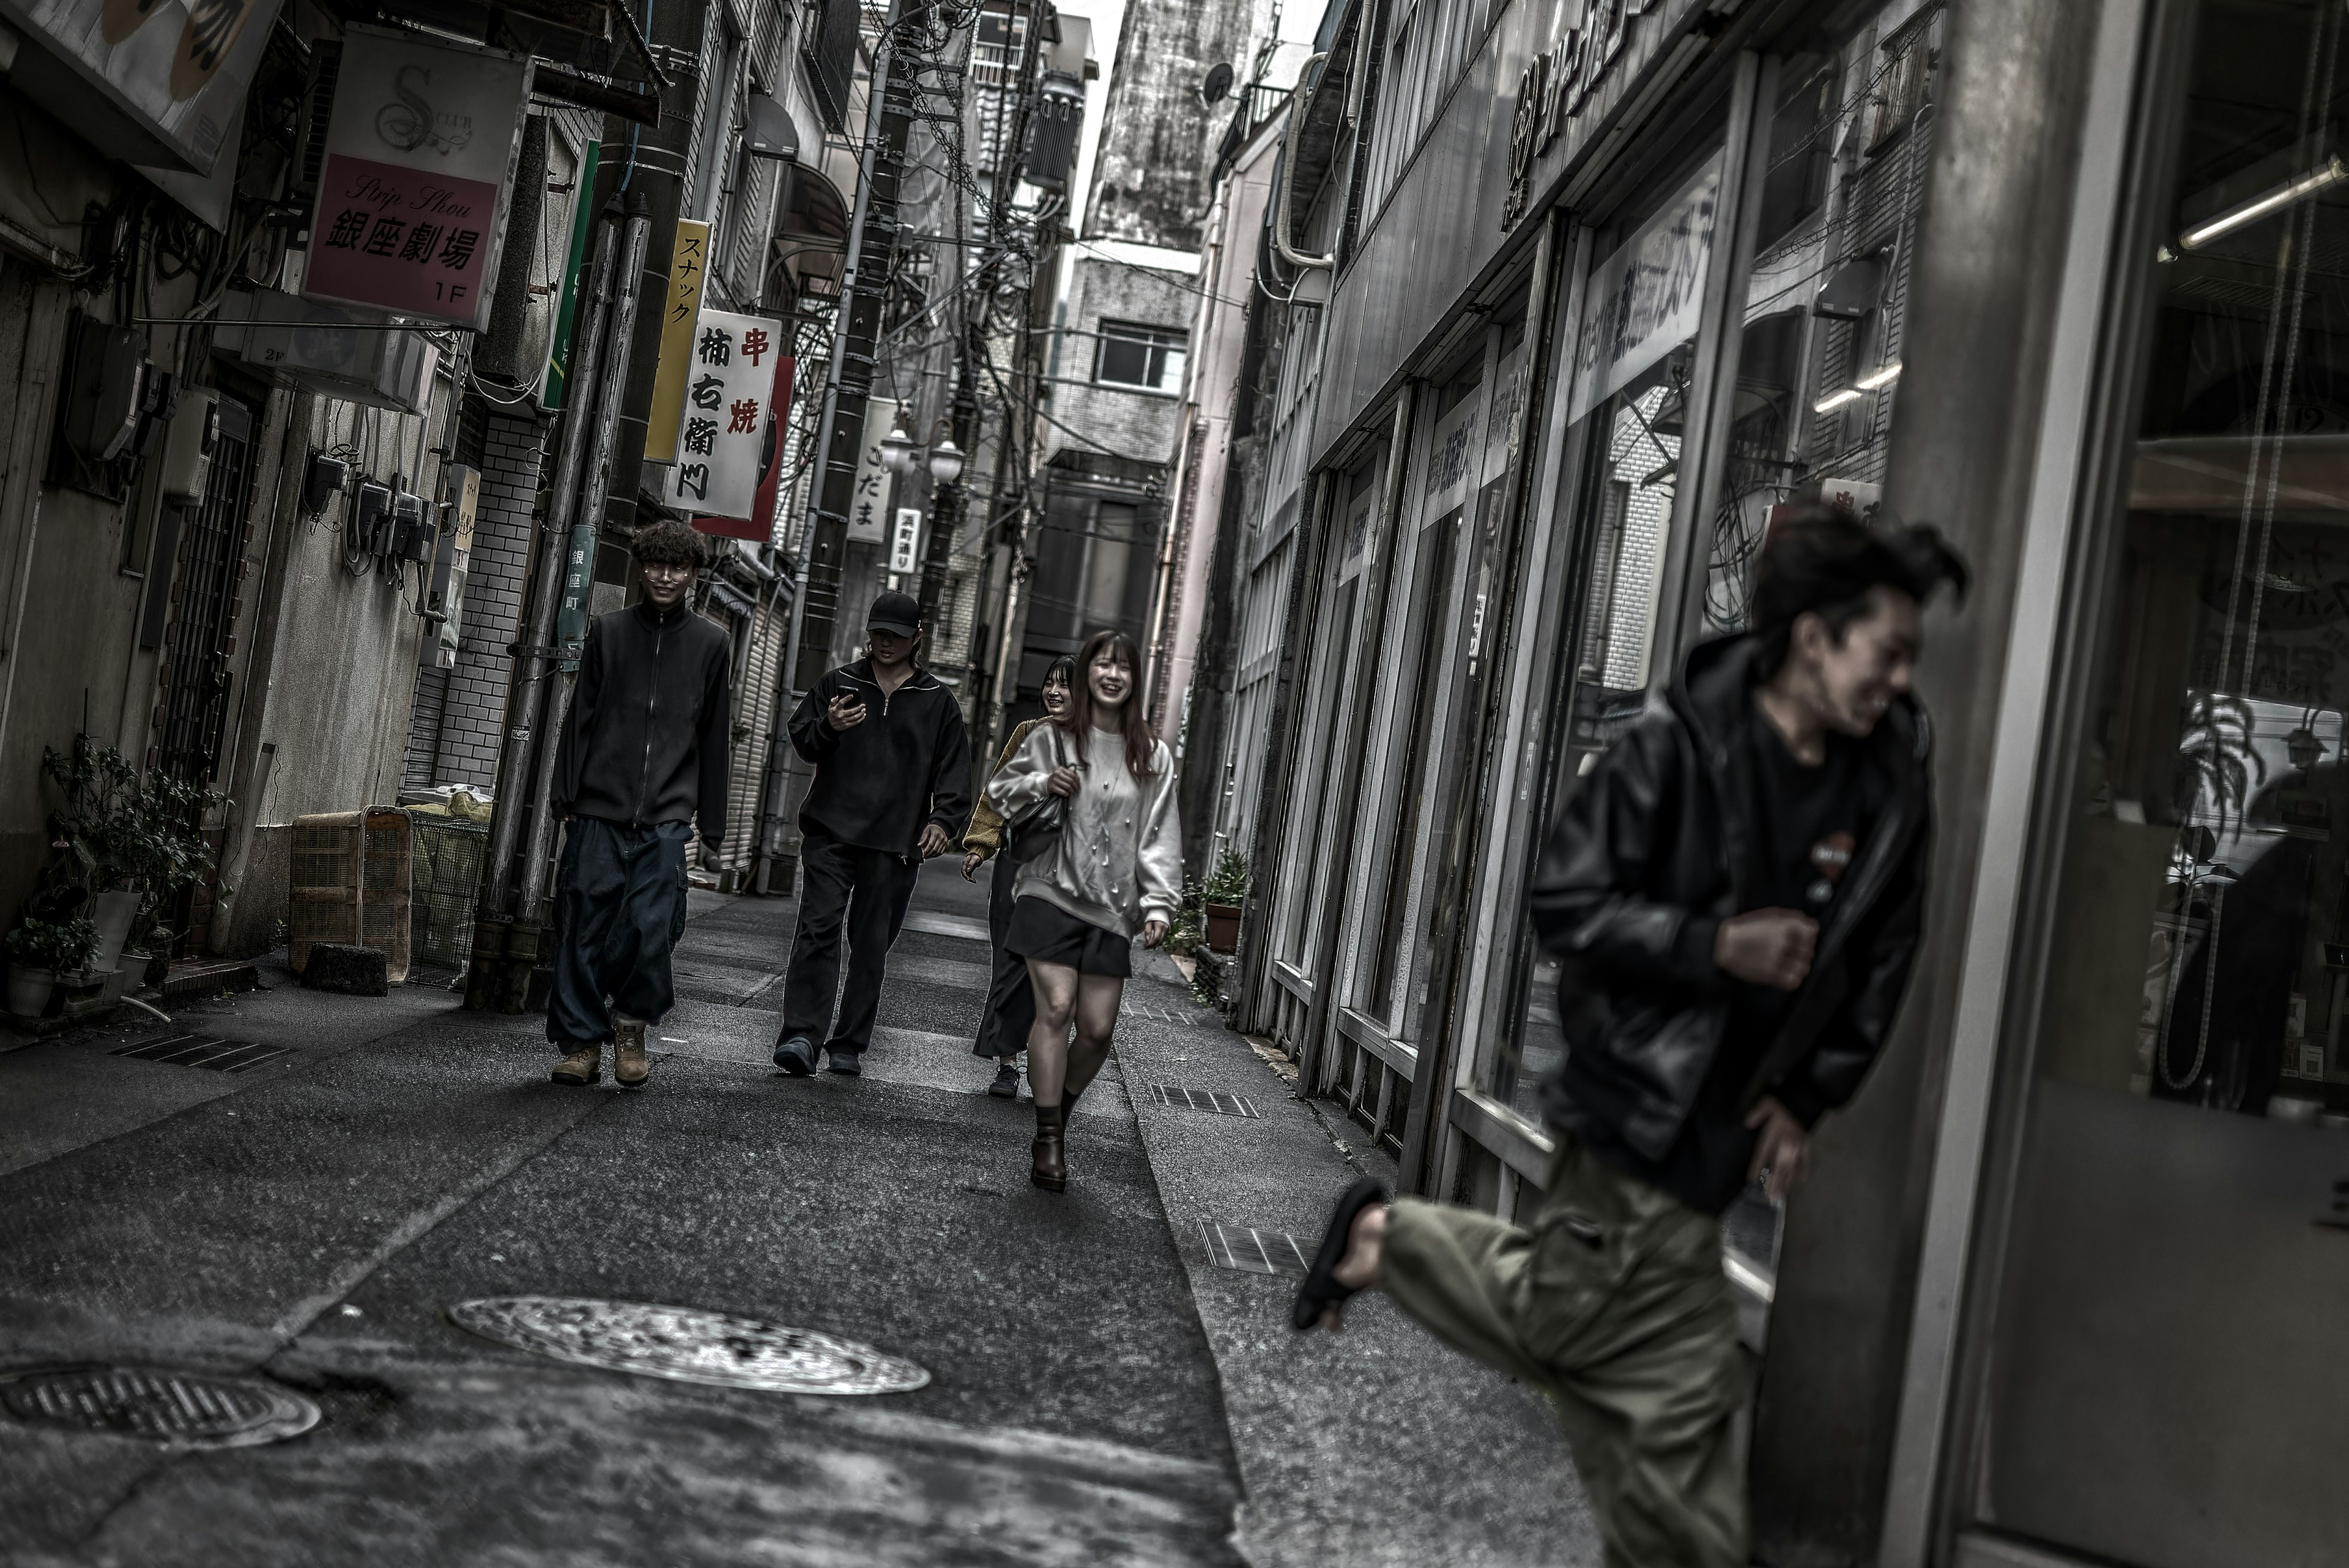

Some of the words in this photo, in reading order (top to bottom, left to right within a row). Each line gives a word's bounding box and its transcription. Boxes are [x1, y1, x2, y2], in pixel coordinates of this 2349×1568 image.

[345, 175, 401, 212] Strip
[325, 209, 480, 270] 銀座劇場
[436, 282, 467, 303] 1F
[672, 237, 701, 324] スナック
[264, 348, 285, 362] 2F
[727, 328, 770, 435] 串焼
[565, 551, 584, 611] 銀座町
